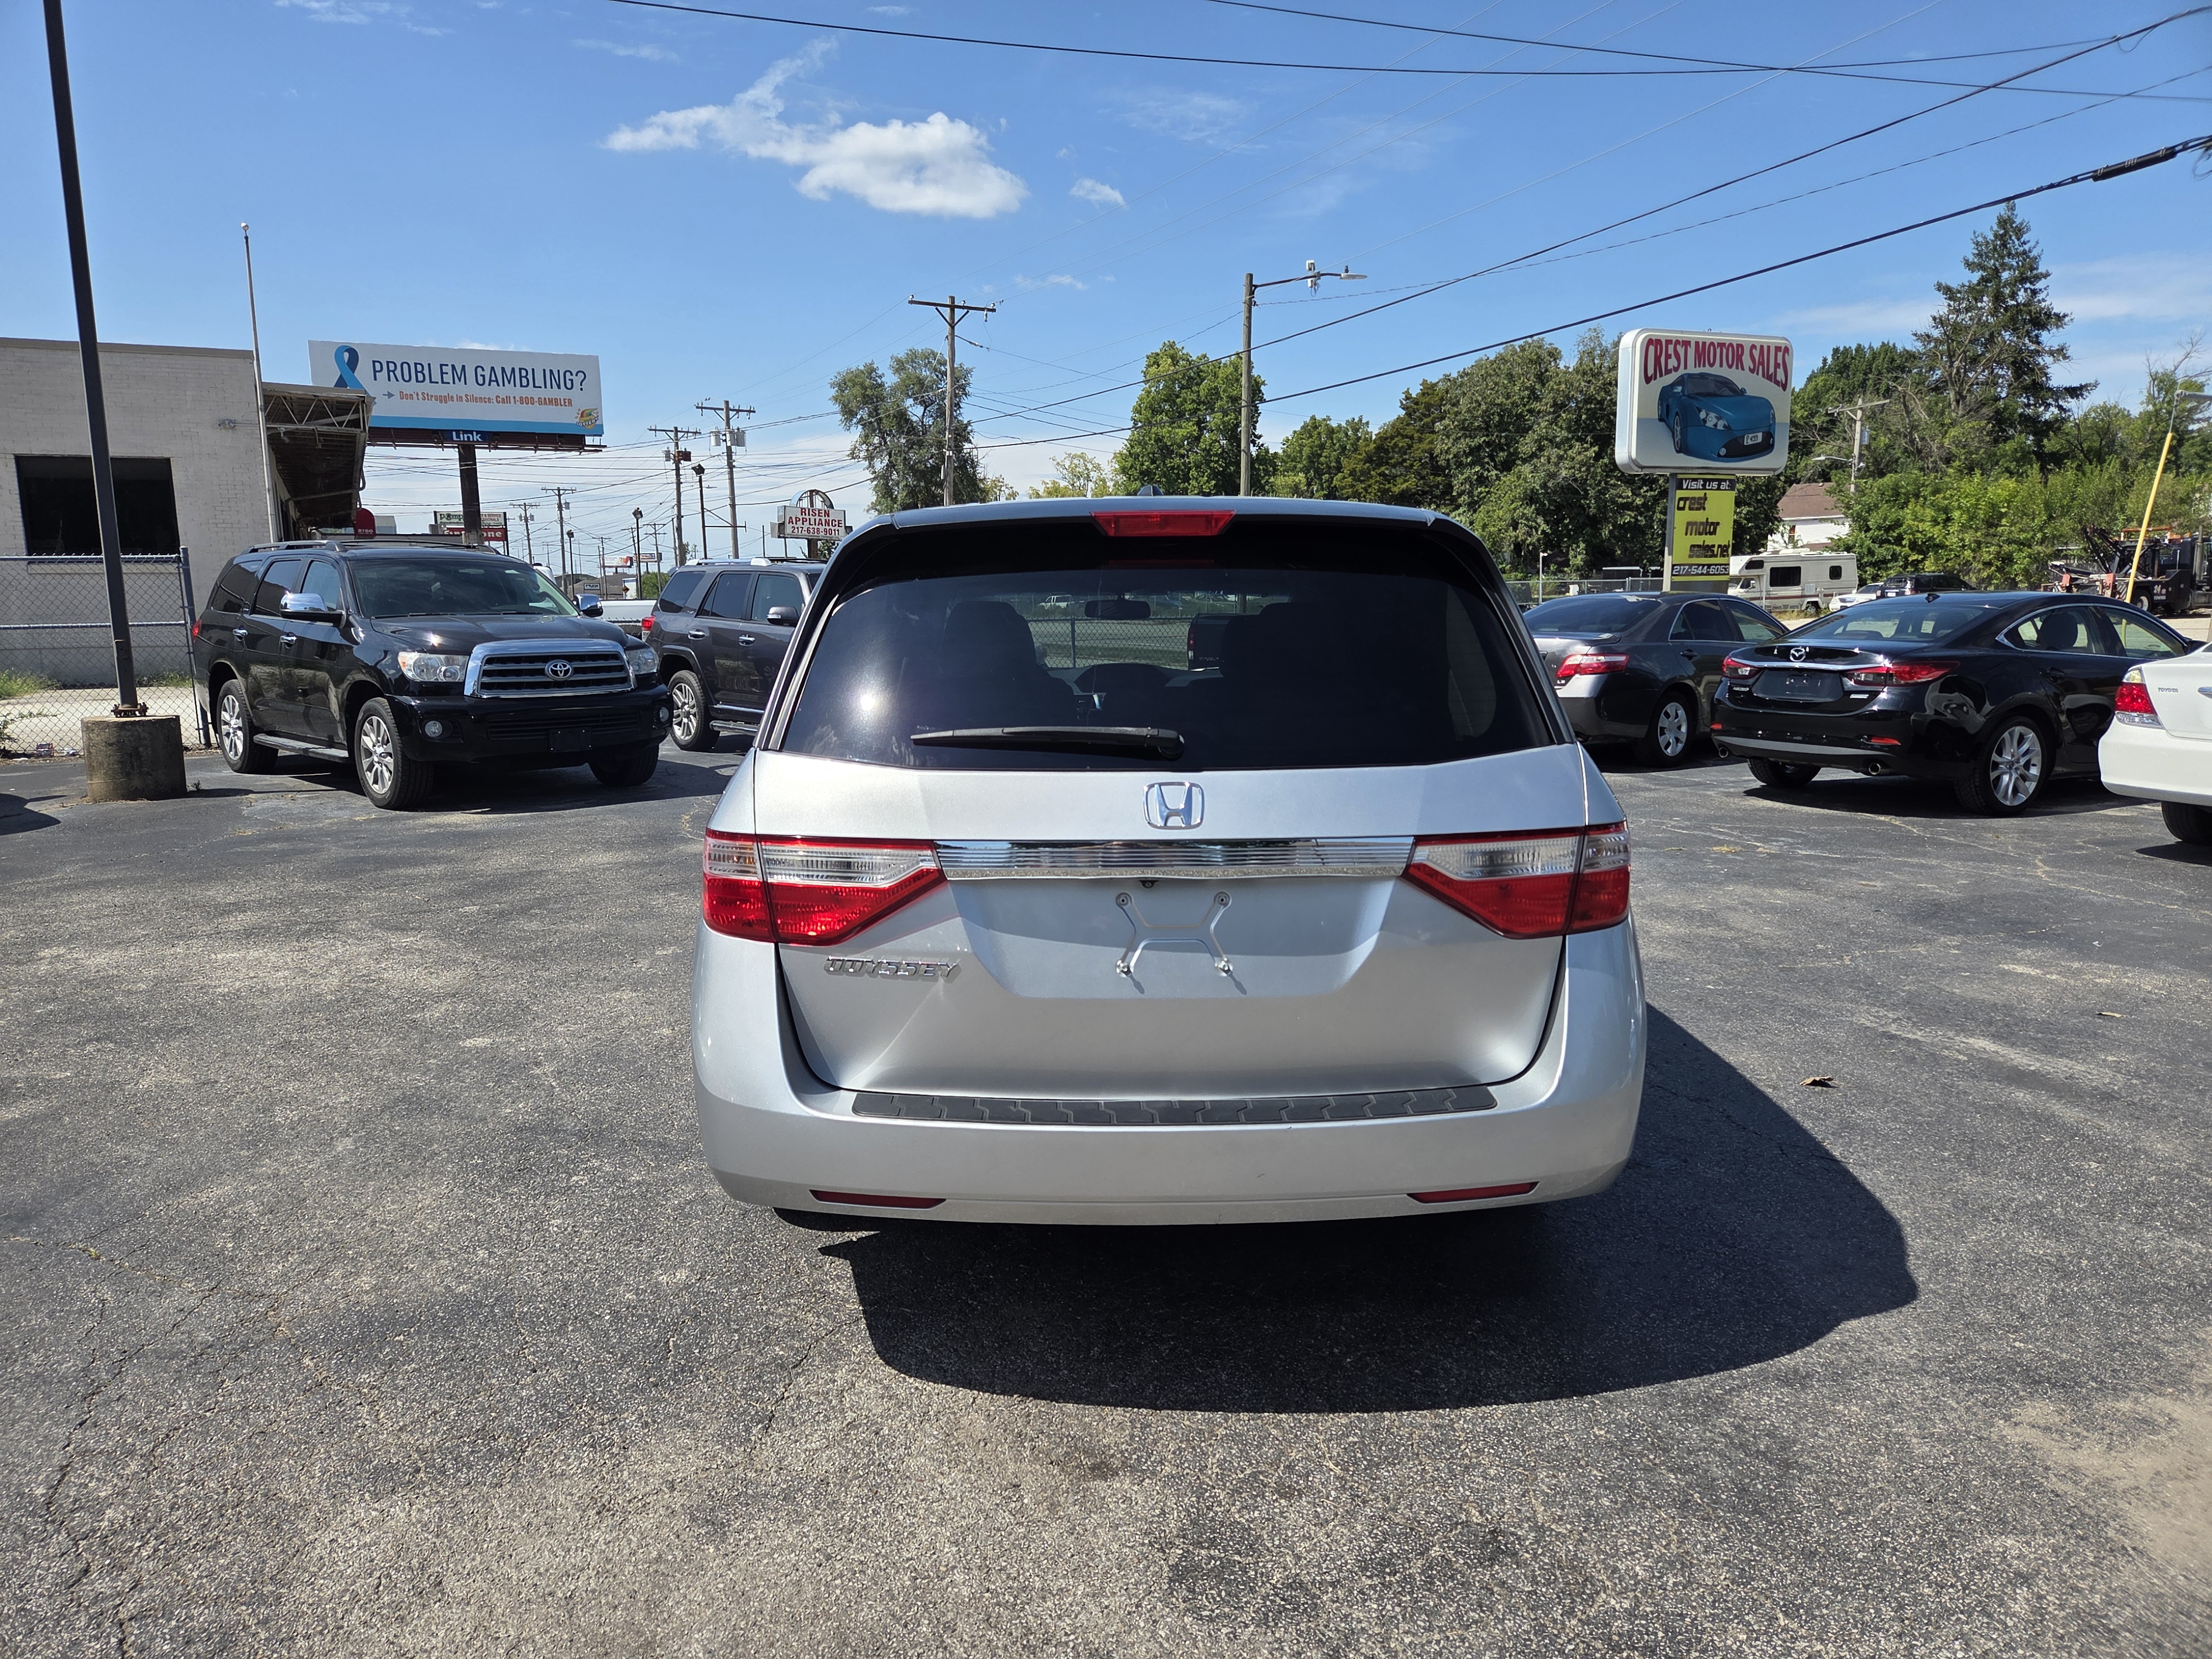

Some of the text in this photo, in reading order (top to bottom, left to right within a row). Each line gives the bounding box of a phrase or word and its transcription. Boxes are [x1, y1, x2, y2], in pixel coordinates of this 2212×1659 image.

[1644, 337, 1790, 392] CREST MOTOR SALES
[372, 359, 587, 392] PROBLEM GAMBLING?
[399, 390, 420, 401] Don't
[421, 392, 455, 404] Struggle
[465, 393, 494, 404] Silence:
[495, 395, 511, 404] Call
[512, 395, 573, 407] 1-800-GAMBLER
[452, 431, 483, 441] Link
[1682, 479, 1731, 489] Visit us at:
[1676, 492, 1708, 512] crest
[800, 508, 830, 518] RISEN
[788, 516, 843, 528] APPLIANCE
[1684, 517, 1720, 536] motor
[791, 526, 839, 536] 217-638-9011
[1688, 540, 1730, 559] sales.net
[1672, 565, 1729, 575] 217-544-6053
[825, 956, 960, 979] ODYSSEY
